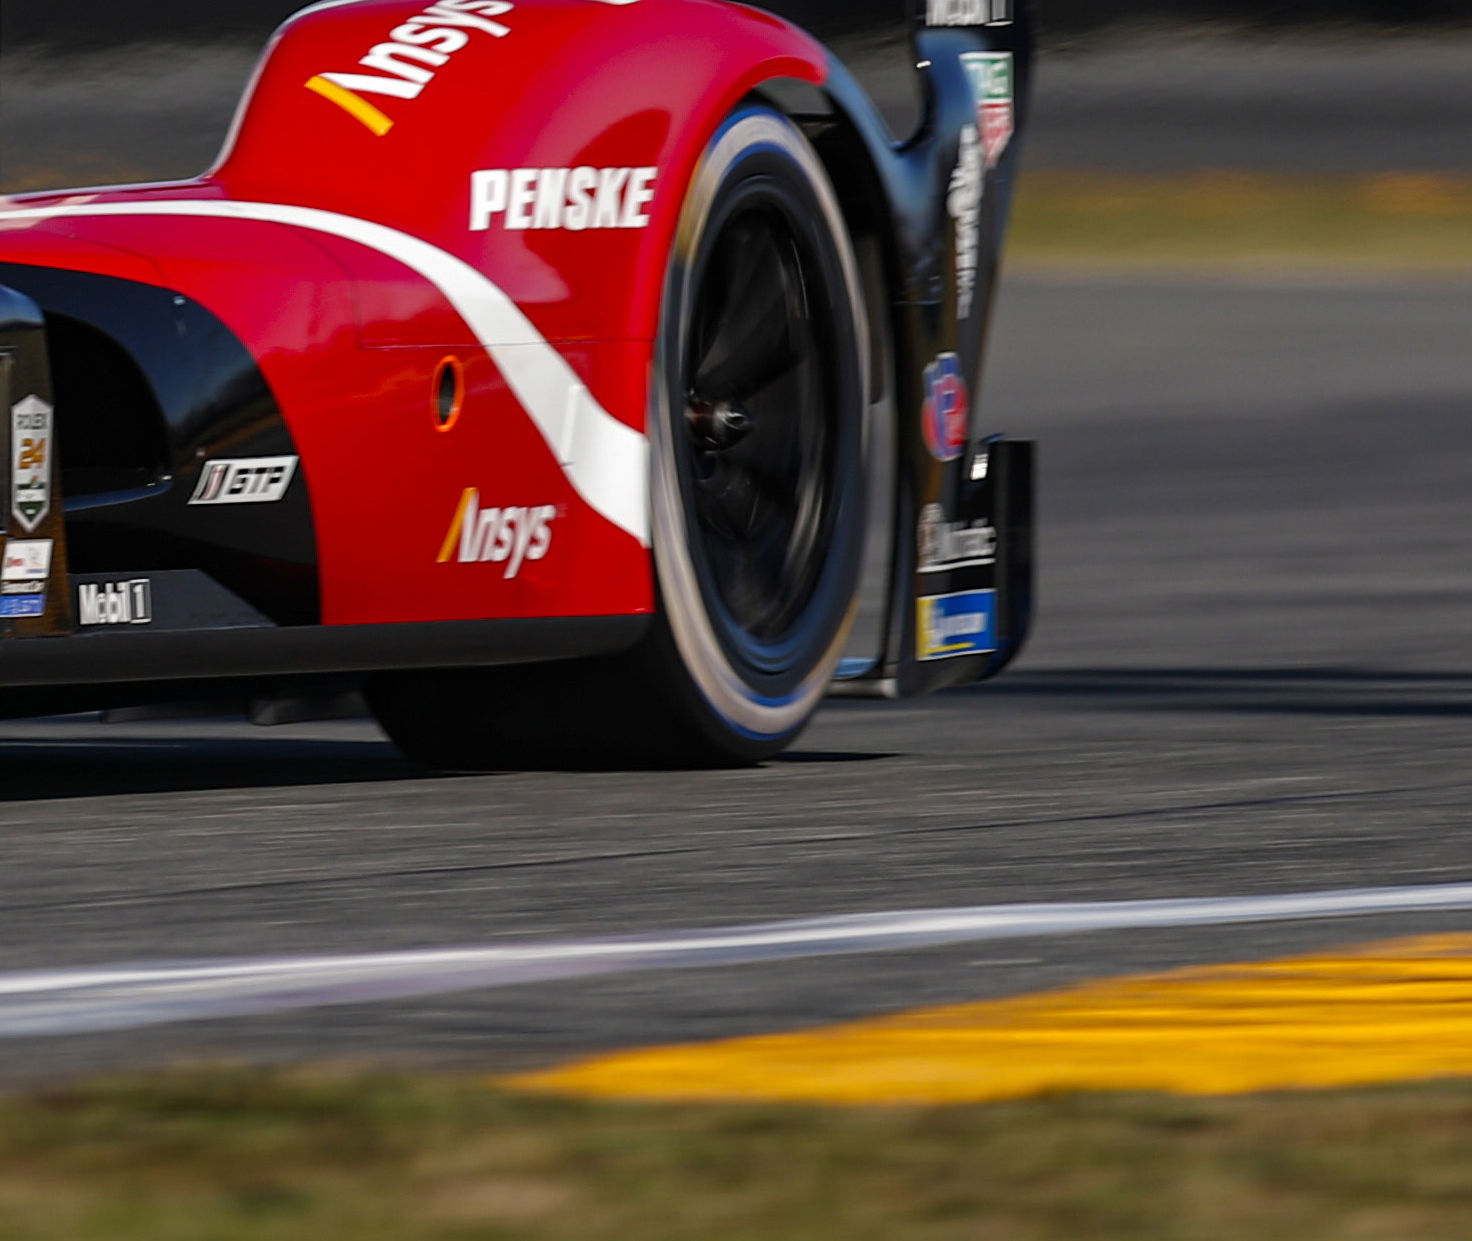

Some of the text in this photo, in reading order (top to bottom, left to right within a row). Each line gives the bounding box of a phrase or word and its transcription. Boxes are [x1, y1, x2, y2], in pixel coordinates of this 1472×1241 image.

[468, 165, 657, 231] PENSKE
[436, 487, 557, 579] Ansys
[78, 582, 130, 625] Mobil
